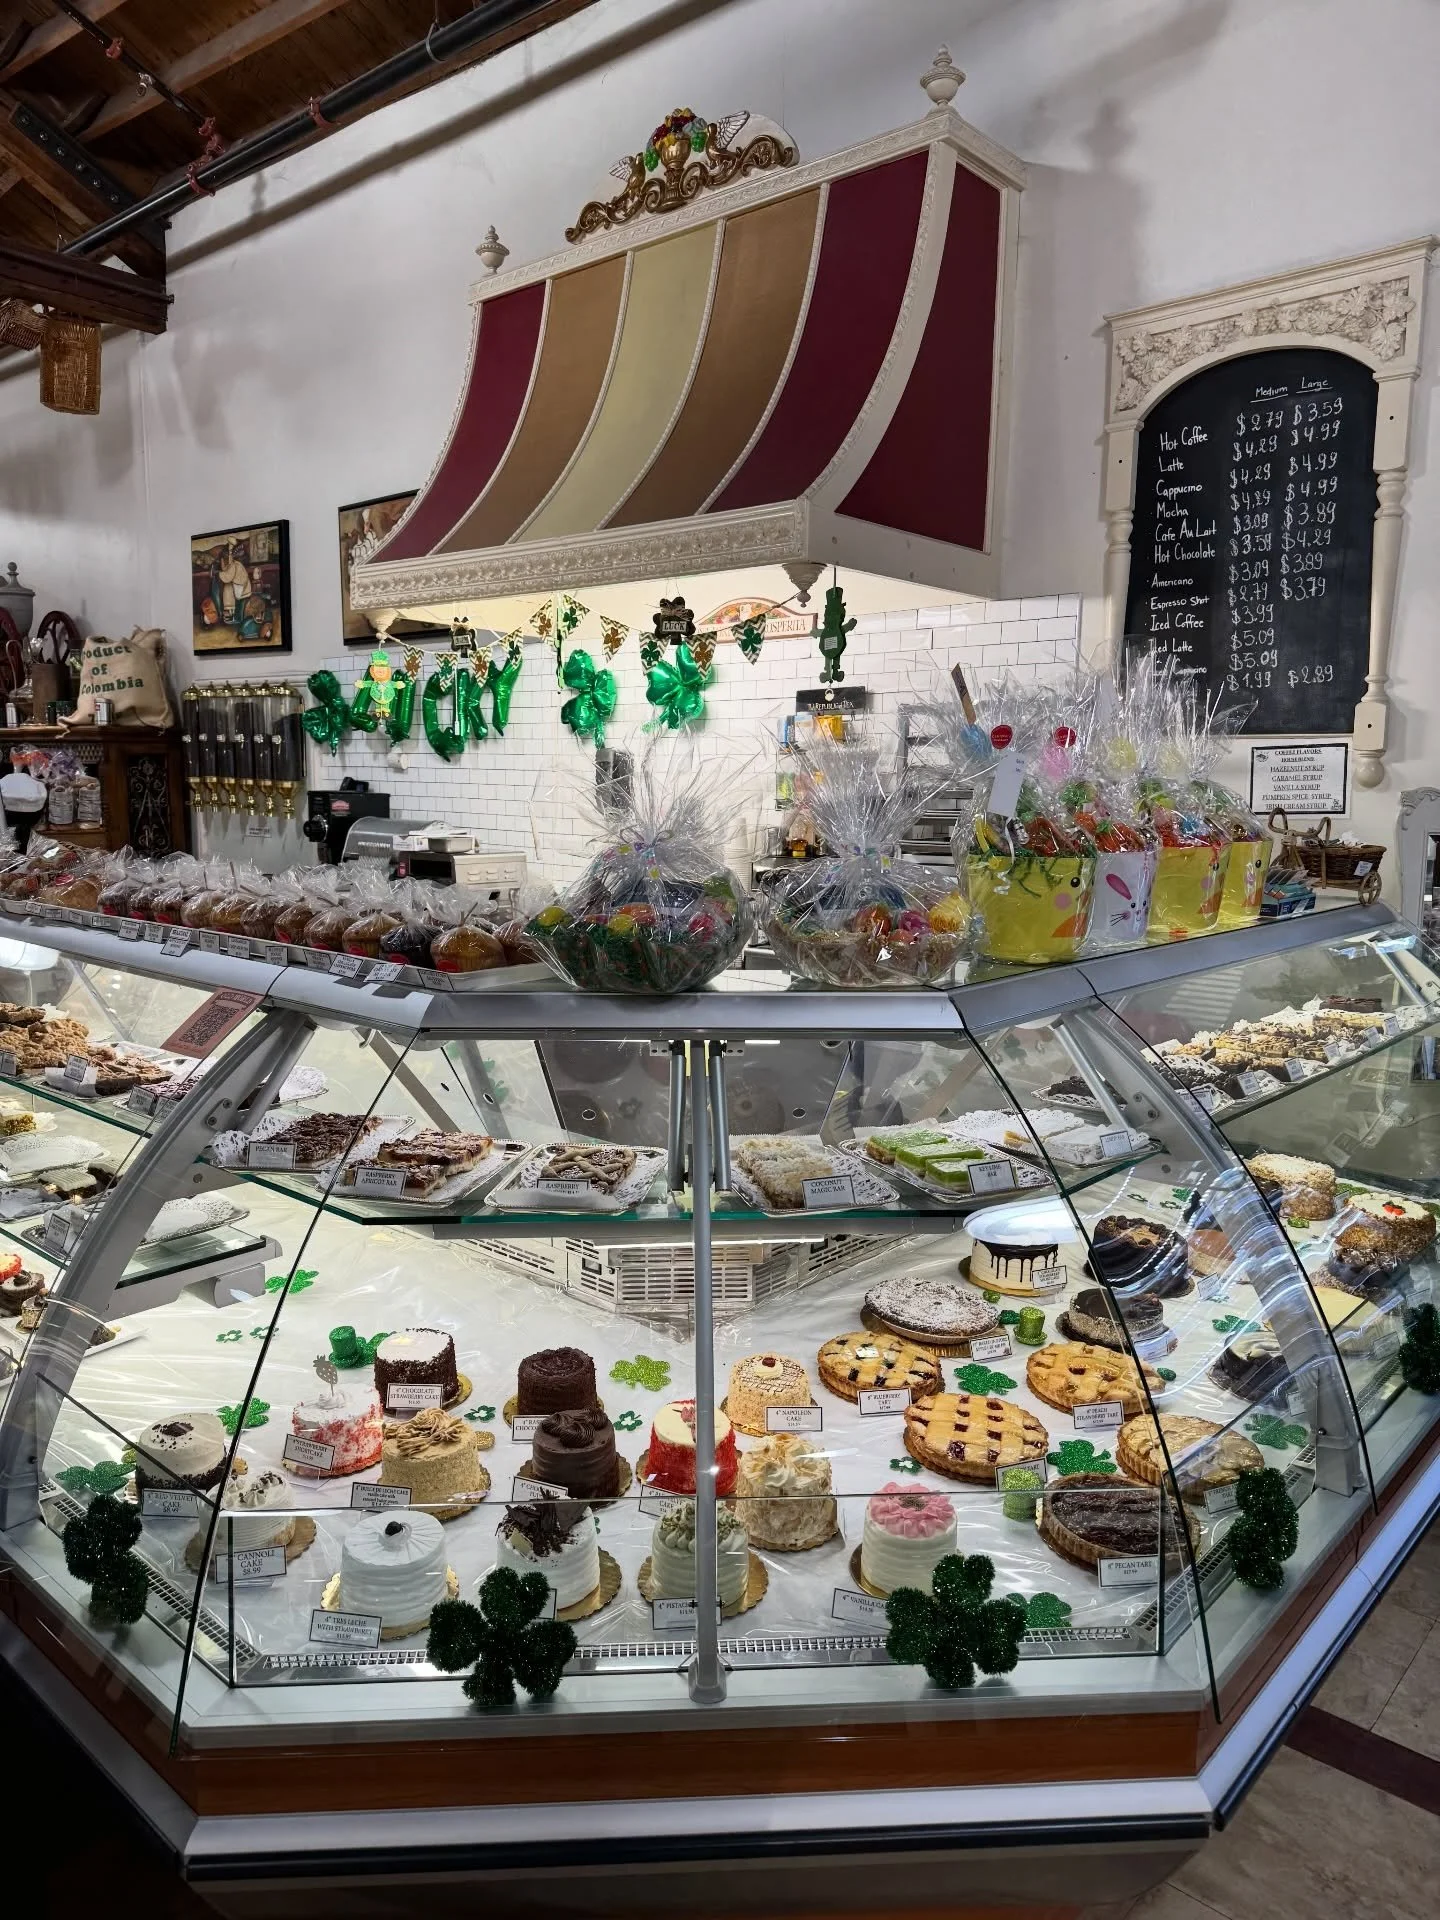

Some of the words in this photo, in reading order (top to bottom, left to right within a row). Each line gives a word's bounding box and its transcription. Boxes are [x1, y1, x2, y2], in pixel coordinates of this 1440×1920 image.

[1255, 386, 1288, 398] Medium
[1301, 377, 1329, 392] Large
[1160, 432, 1178, 451] Hot
[1181, 425, 1209, 446] Coffee
[1159, 456, 1184, 472] Latte
[1157, 502, 1189, 519] Mocha
[1156, 523, 1176, 541] Cafe
[1180, 518, 1194, 540] Au
[1196, 518, 1217, 537] Lait
[1155, 545, 1170, 564] Hot
[1174, 541, 1216, 560] Chocolate
[1151, 573, 1194, 588] Americano
[1150, 596, 1187, 610] Espresso
[1190, 595, 1210, 606] Shot
[663, 622, 686, 631] LUCK
[1150, 612, 1170, 631] Iced
[1175, 612, 1204, 629] Coffee
[1173, 638, 1193, 652] Latte
[91, 663, 107, 676] of
[81, 676, 144, 695] Colombia
[366, 1171, 395, 1180] RASPBERRY
[360, 1178, 386, 1186] APRICOT
[810, 1179, 842, 1187] COCONUT
[811, 1186, 833, 1194] MAGIC
[294, 1446, 323, 1458] SHORTCAKE
[297, 1440, 328, 1452] STRAWBERRY
[170, 1494, 194, 1502] VELVET
[237, 1550, 275, 1560] CANNOLI
[240, 1559, 263, 1568] CAKE
[242, 1566, 262, 1576] $8.99
[658, 1602, 666, 1610] 4"
[850, 1596, 876, 1606] VANILLA
[348, 1618, 367, 1626] LECHE
[333, 1626, 373, 1636] STRAWBERRY
